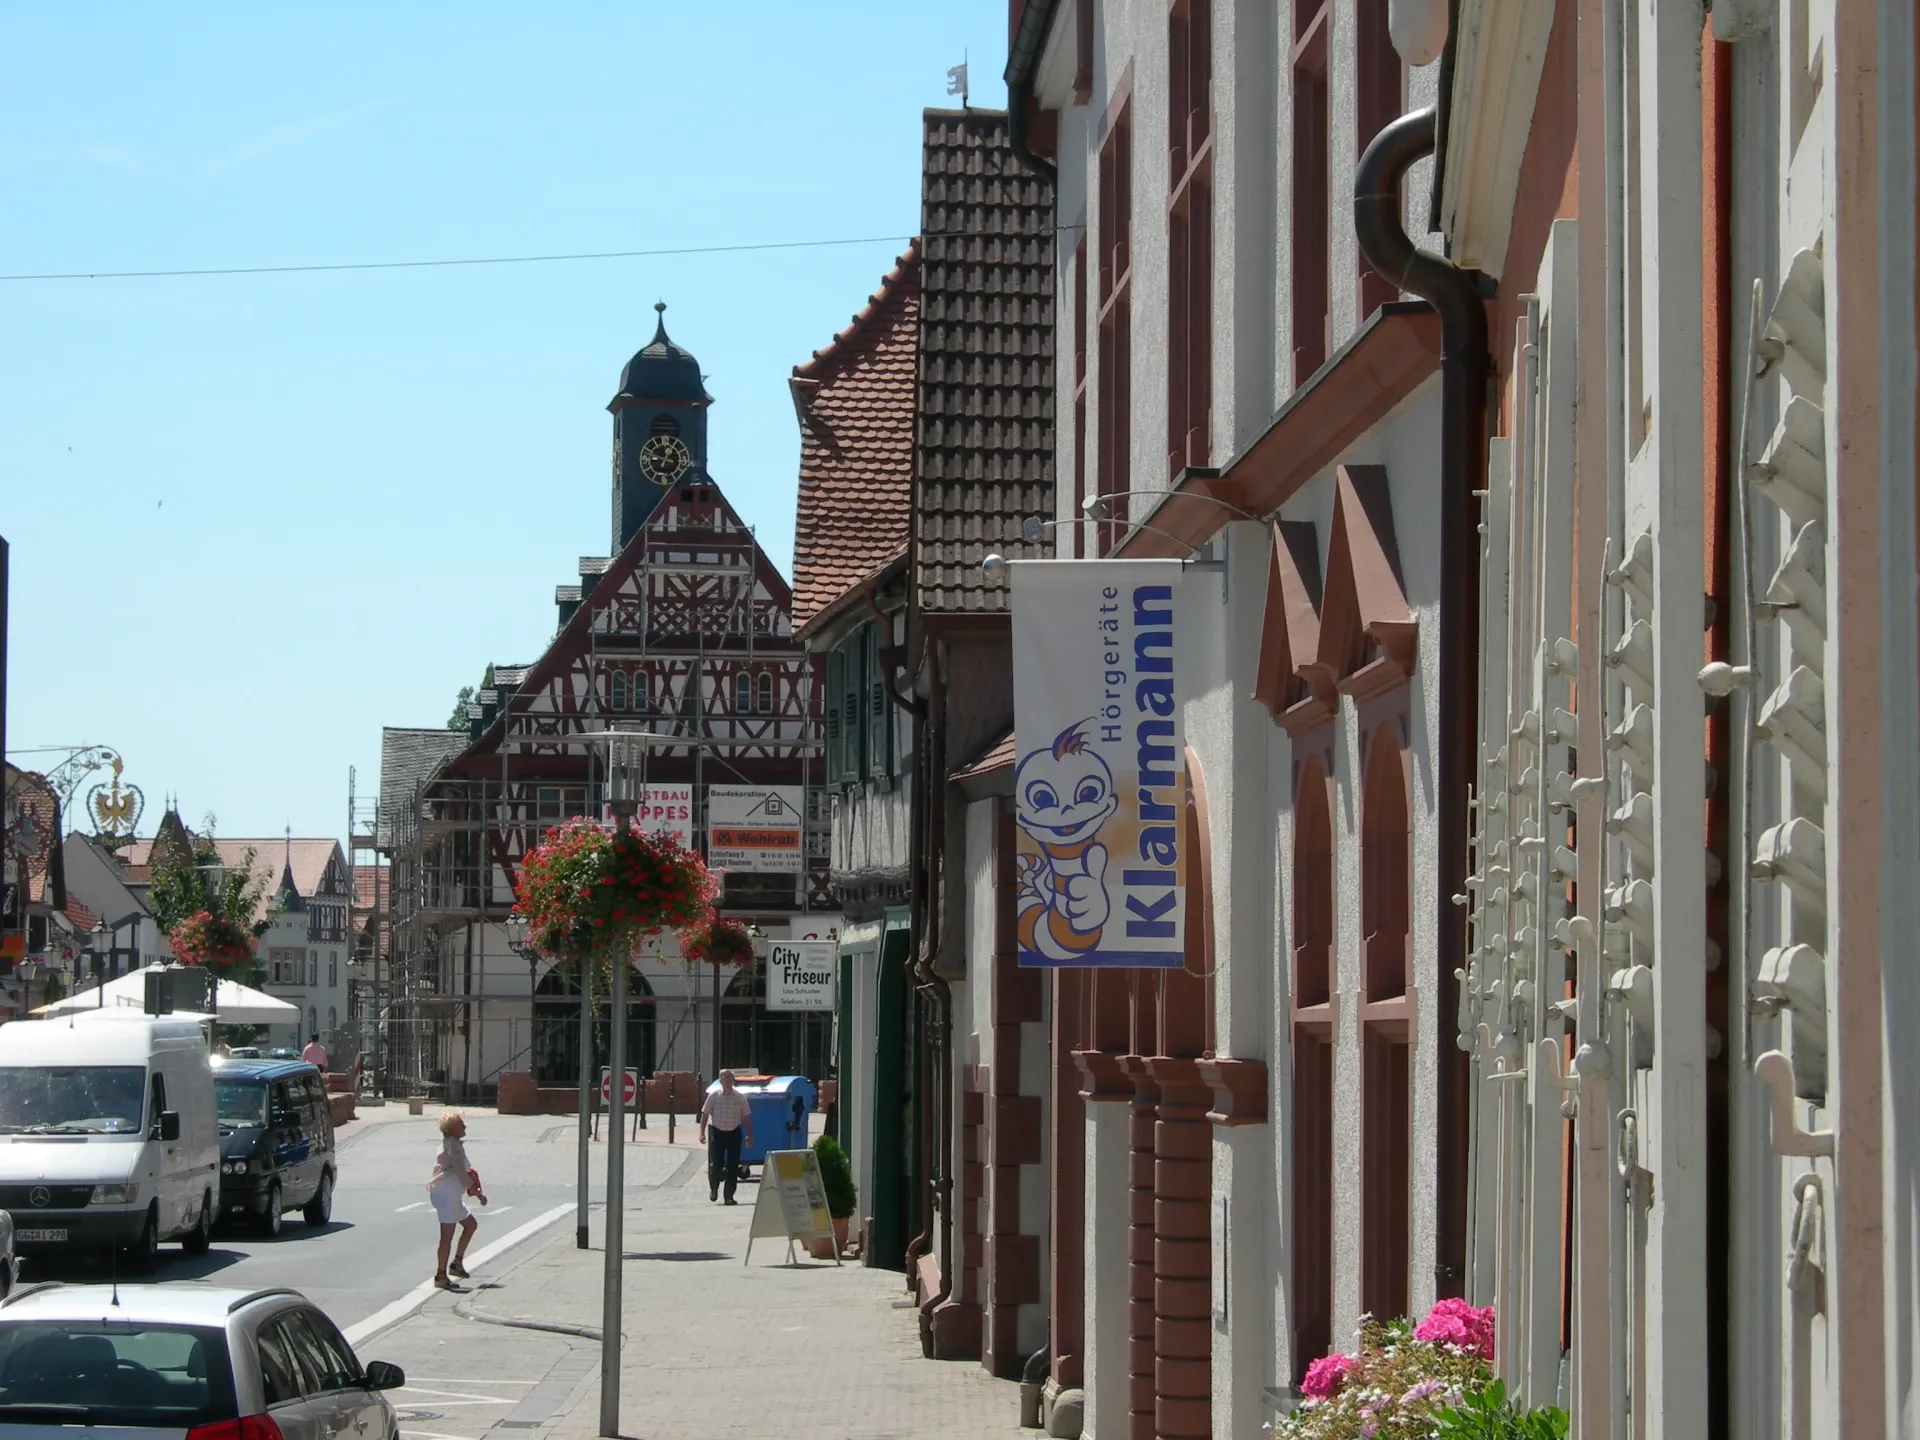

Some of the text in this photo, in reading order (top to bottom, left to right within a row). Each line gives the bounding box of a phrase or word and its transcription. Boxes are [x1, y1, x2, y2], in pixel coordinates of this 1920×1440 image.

[1099, 586, 1127, 742] Hörgeräte
[1123, 585, 1177, 938] Klarmann
[711, 790, 767, 798] Baudekoration
[737, 832, 796, 845] Wohlrab
[773, 947, 800, 970] City
[784, 966, 831, 985] Friseur
